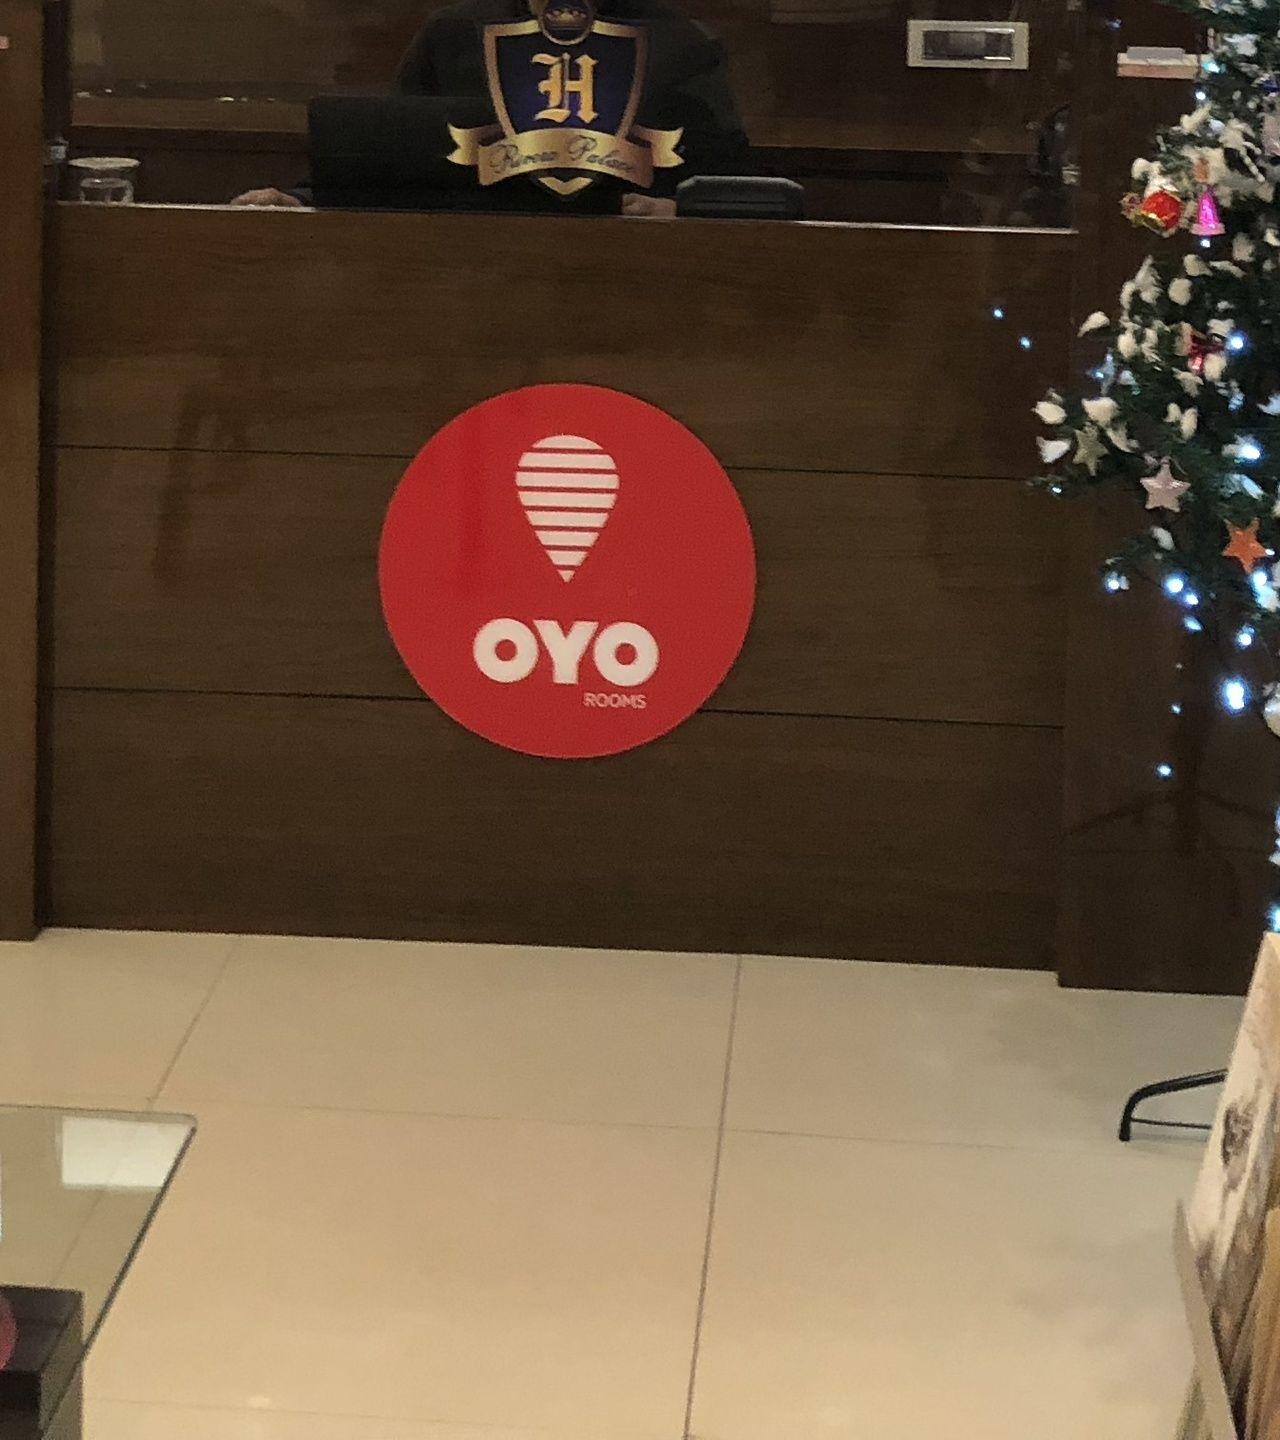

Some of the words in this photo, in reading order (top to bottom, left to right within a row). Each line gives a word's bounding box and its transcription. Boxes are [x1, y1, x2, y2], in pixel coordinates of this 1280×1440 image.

[531, 52, 599, 124] H
[473, 617, 660, 688] OYO
[582, 691, 648, 710] ROOMS
